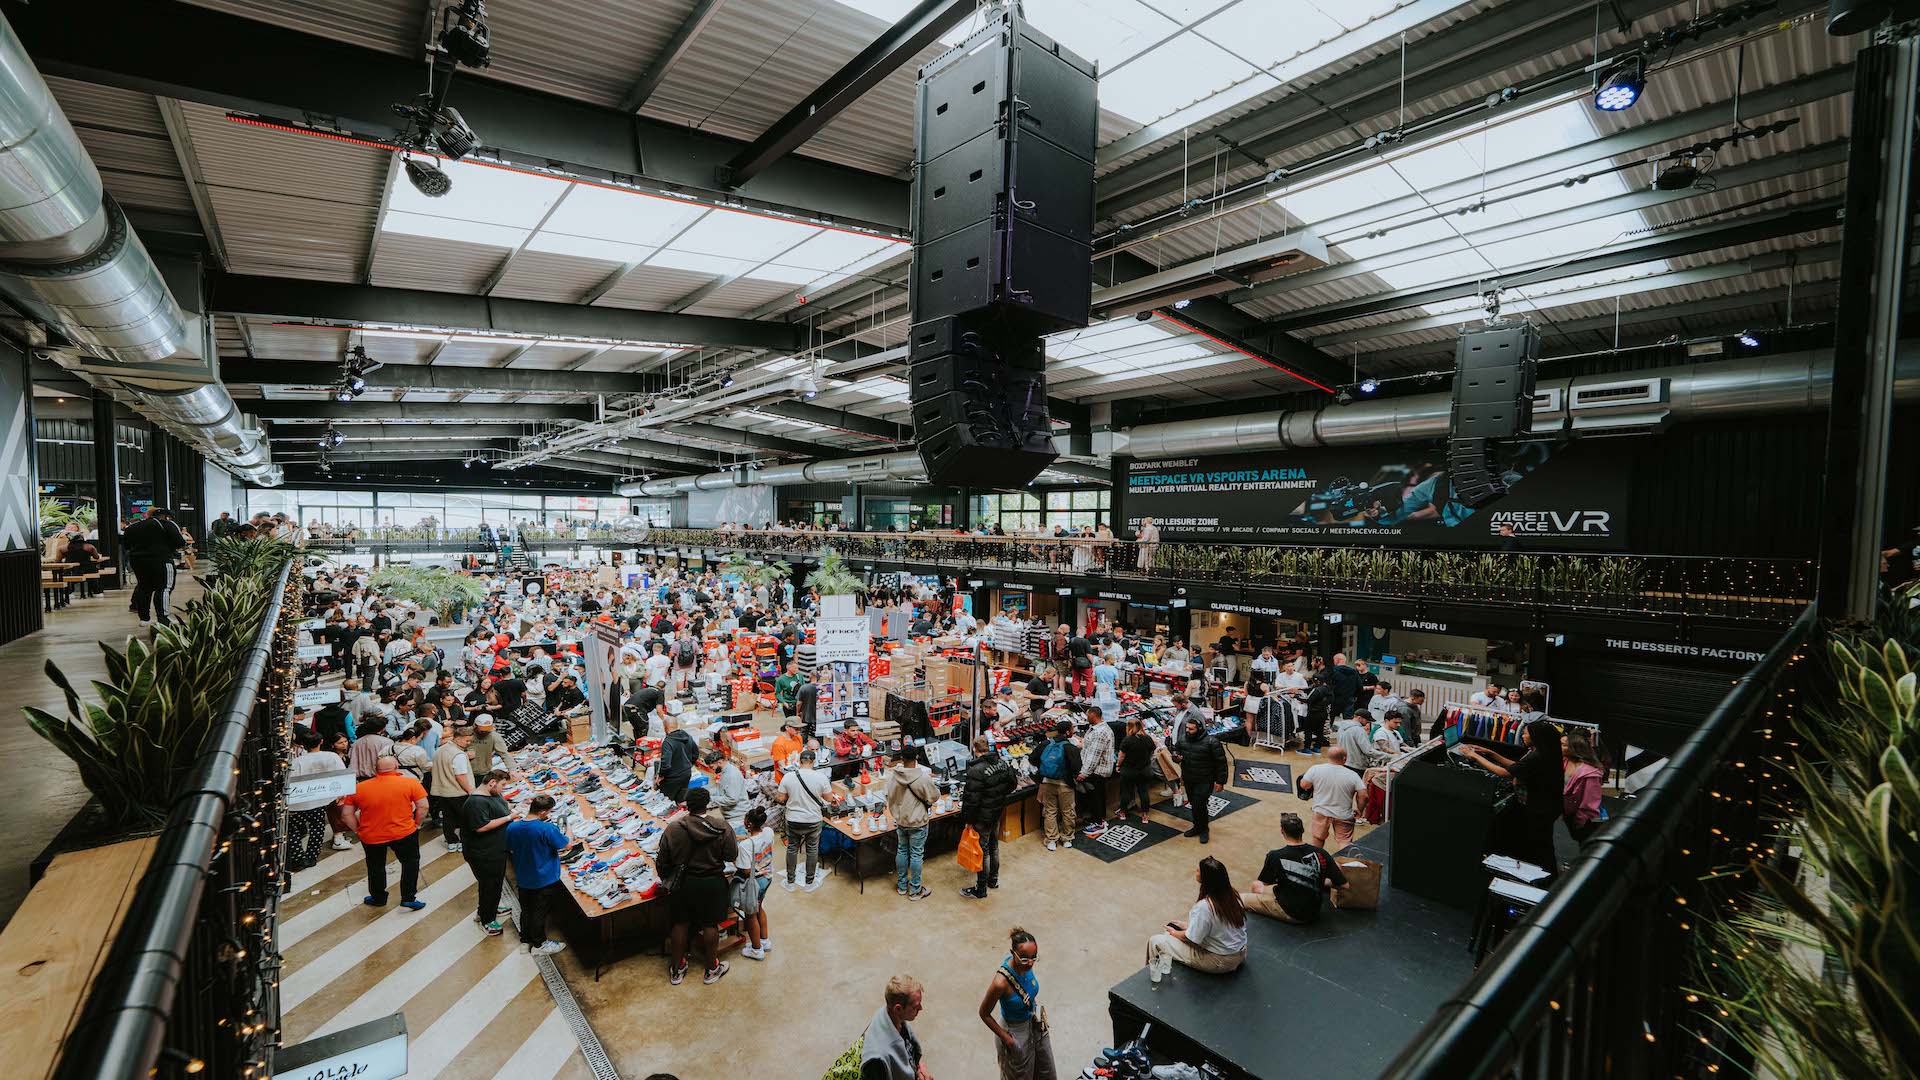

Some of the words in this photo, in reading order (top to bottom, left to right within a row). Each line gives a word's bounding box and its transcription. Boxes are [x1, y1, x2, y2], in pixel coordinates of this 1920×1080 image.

[1129, 461, 1161, 470] BOXPARK
[1162, 459, 1198, 468] WEMBLEY
[1129, 473, 1188, 486] MEETSPACE
[1189, 473, 1205, 483] VR
[1206, 470, 1259, 482] VSPORTS
[1261, 468, 1307, 480] ARENA
[1129, 485, 1175, 494] MULTIPLAYER
[1208, 483, 1242, 491] REALITY
[1243, 480, 1317, 490] ENTERTAINMENT
[1128, 518, 1140, 526] 1ST
[1165, 518, 1197, 526] LEISURE
[1197, 518, 1219, 526] ZONE
[1490, 511, 1549, 521] MEET
[1549, 510, 1610, 532] VR
[1490, 522, 1548, 531] SACE
[1211, 602, 1239, 612] OLIVER'S
[1261, 608, 1282, 616] CHIPS
[1401, 620, 1419, 629] TEA
[1420, 621, 1439, 630] FOR
[1606, 638, 1630, 649] THE
[1632, 641, 1699, 656] DESSERTS
[1701, 648, 1766, 662] FACTORY
